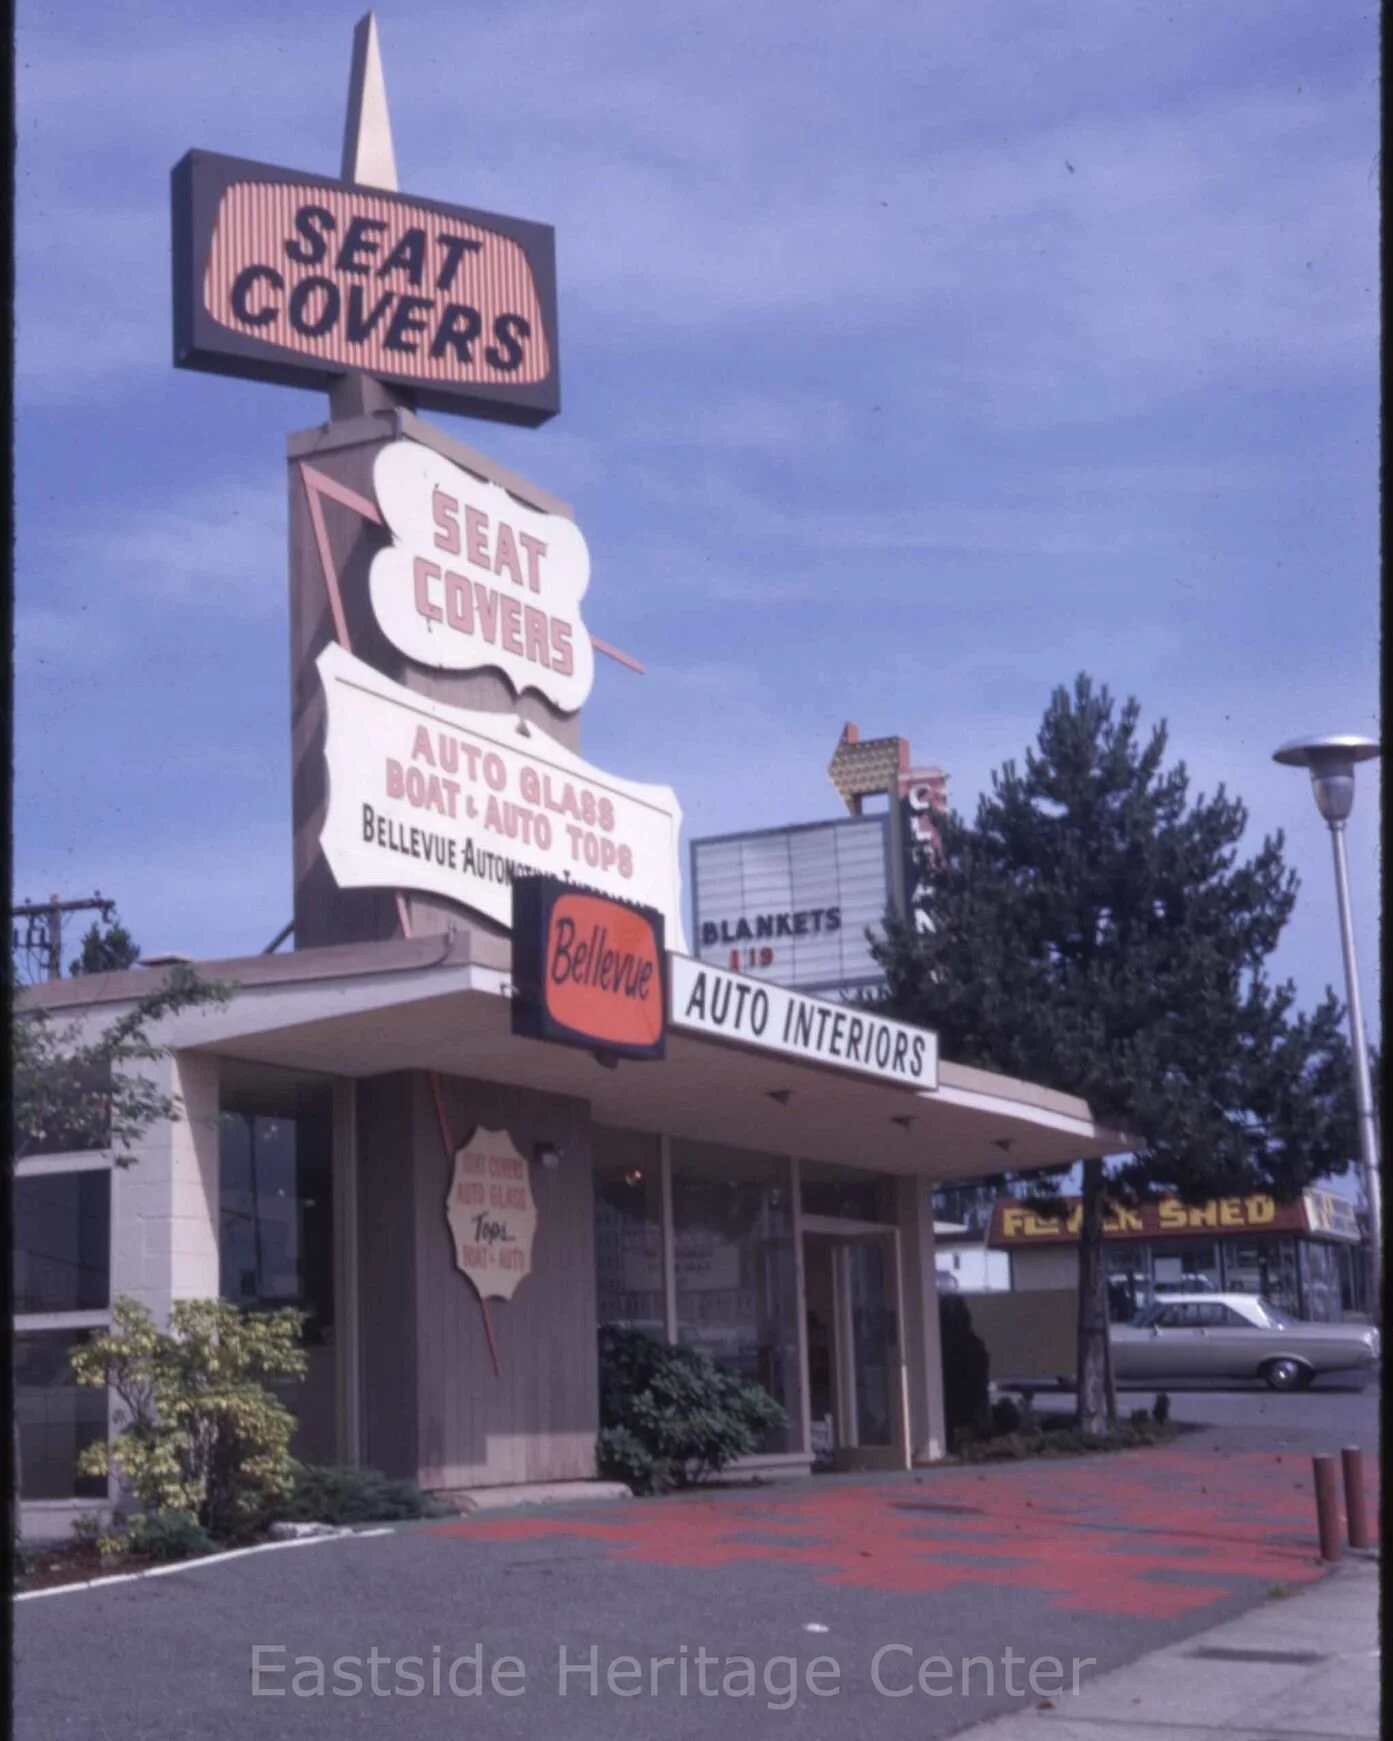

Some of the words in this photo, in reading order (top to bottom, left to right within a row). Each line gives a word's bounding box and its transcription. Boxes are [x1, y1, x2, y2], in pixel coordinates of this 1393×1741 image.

[284, 204, 482, 292] SEAT
[230, 264, 532, 374] COVERS
[432, 490, 547, 595] SEAT
[412, 556, 575, 678] COVERS
[385, 757, 462, 820] BOAT
[484, 795, 552, 852] AUTO
[567, 823, 635, 879] TOPS
[411, 725, 507, 792] AUTO
[519, 766, 616, 833] GLASS
[362, 803, 457, 870] BELLEVUE
[551, 915, 654, 1001] Bellevue
[702, 907, 841, 946] BLANKETS
[684, 971, 769, 1038] AUTO
[782, 997, 927, 1078] INTERIORS
[456, 1182, 485, 1206] AUTO
[489, 1183, 527, 1211] GLASS
[471, 1211, 516, 1245] Tops
[1159, 1193, 1276, 1229] SHED
[498, 1247, 525, 1271] AUTO
